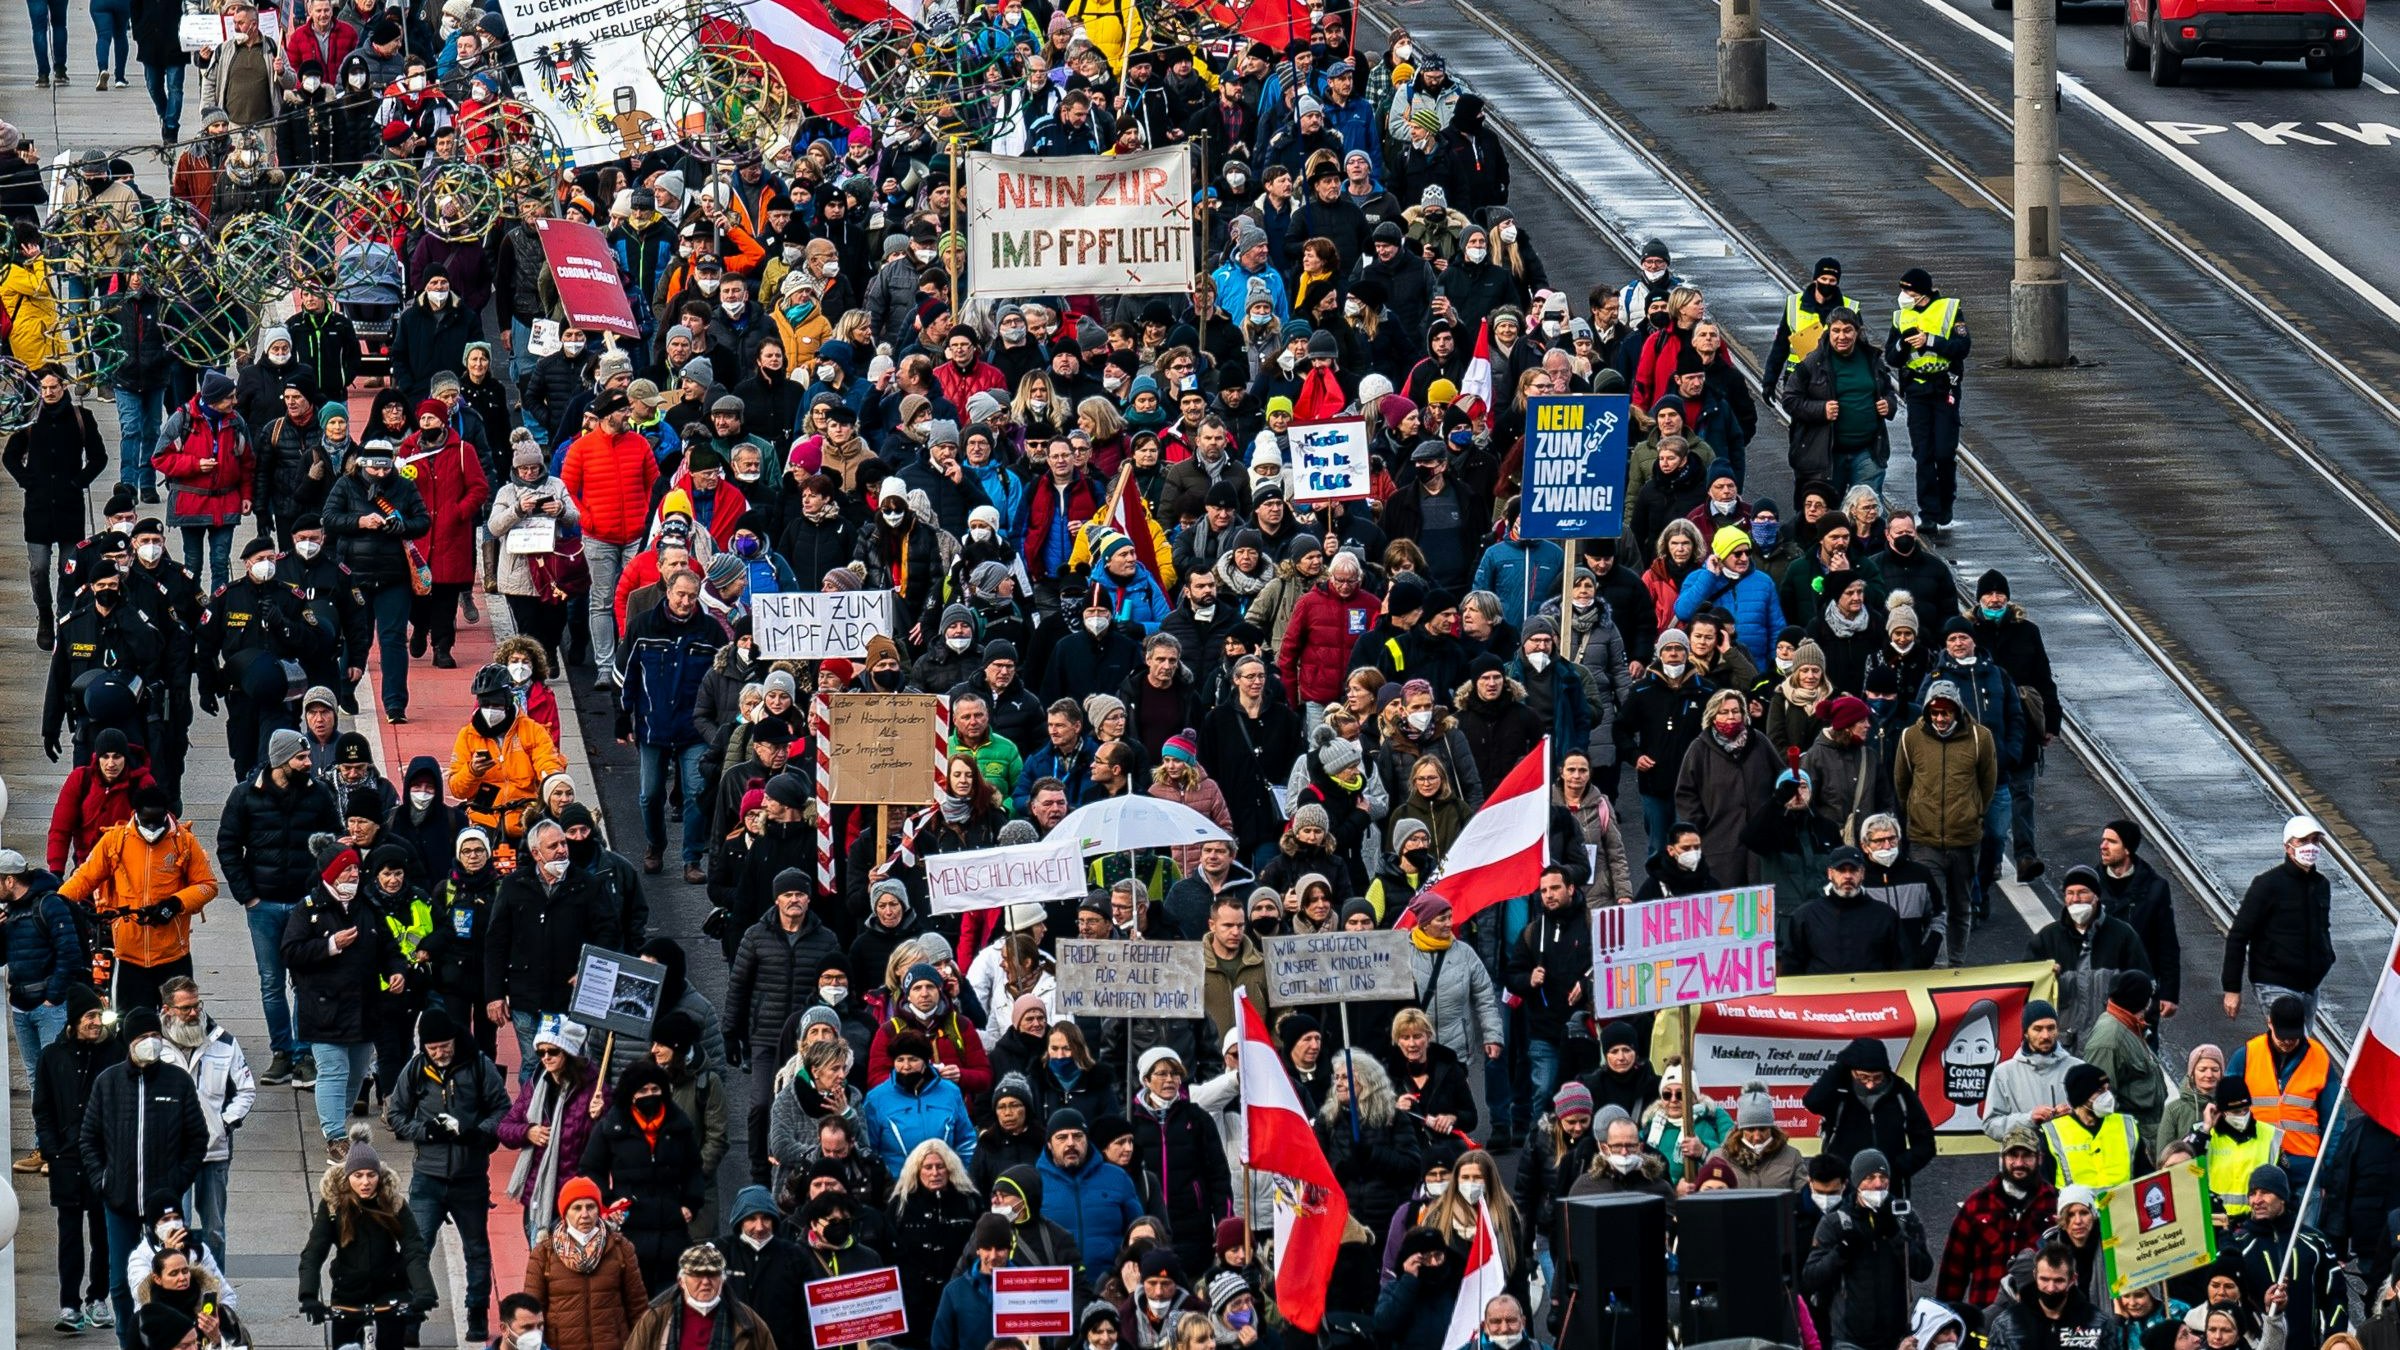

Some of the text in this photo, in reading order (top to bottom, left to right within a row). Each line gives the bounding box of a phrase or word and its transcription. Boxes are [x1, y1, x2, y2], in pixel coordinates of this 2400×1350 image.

[514, 3, 534, 17] ZU
[559, 10, 602, 30] ENDE
[2145, 121, 2400, 145] PKW
[998, 167, 1167, 209] NEIN ZUR
[991, 226, 1191, 269] IMPFPFLICHT
[1537, 405, 1584, 431] NEIN
[1535, 432, 1582, 458] ZUM
[1534, 459, 1596, 485] IMPF-
[1532, 486, 1613, 512] ZWANG!
[762, 595, 884, 620] NEIN ZUM
[834, 713, 852, 725] mit
[929, 856, 1072, 898] MENSCHLICHKEIT
[1642, 897, 1713, 948] NEIN
[1063, 944, 1100, 964] FRIEDE
[1122, 943, 1174, 963] FREIHEIT
[1273, 936, 1368, 956] WIR SCHÜTZEN
[1095, 966, 1160, 985] FÜR ALLE
[1276, 957, 1319, 976] UNSERE
[1279, 974, 1376, 997] GOTT MIT UNS
[1062, 990, 1084, 1007] WIR
[1093, 987, 1147, 1009] KÄMPFEN
[1715, 1002, 1746, 1017] Wem
[1747, 1005, 1777, 1019] dient
[1798, 1048, 1823, 1060] und
[1949, 1066, 1987, 1077] Corona
